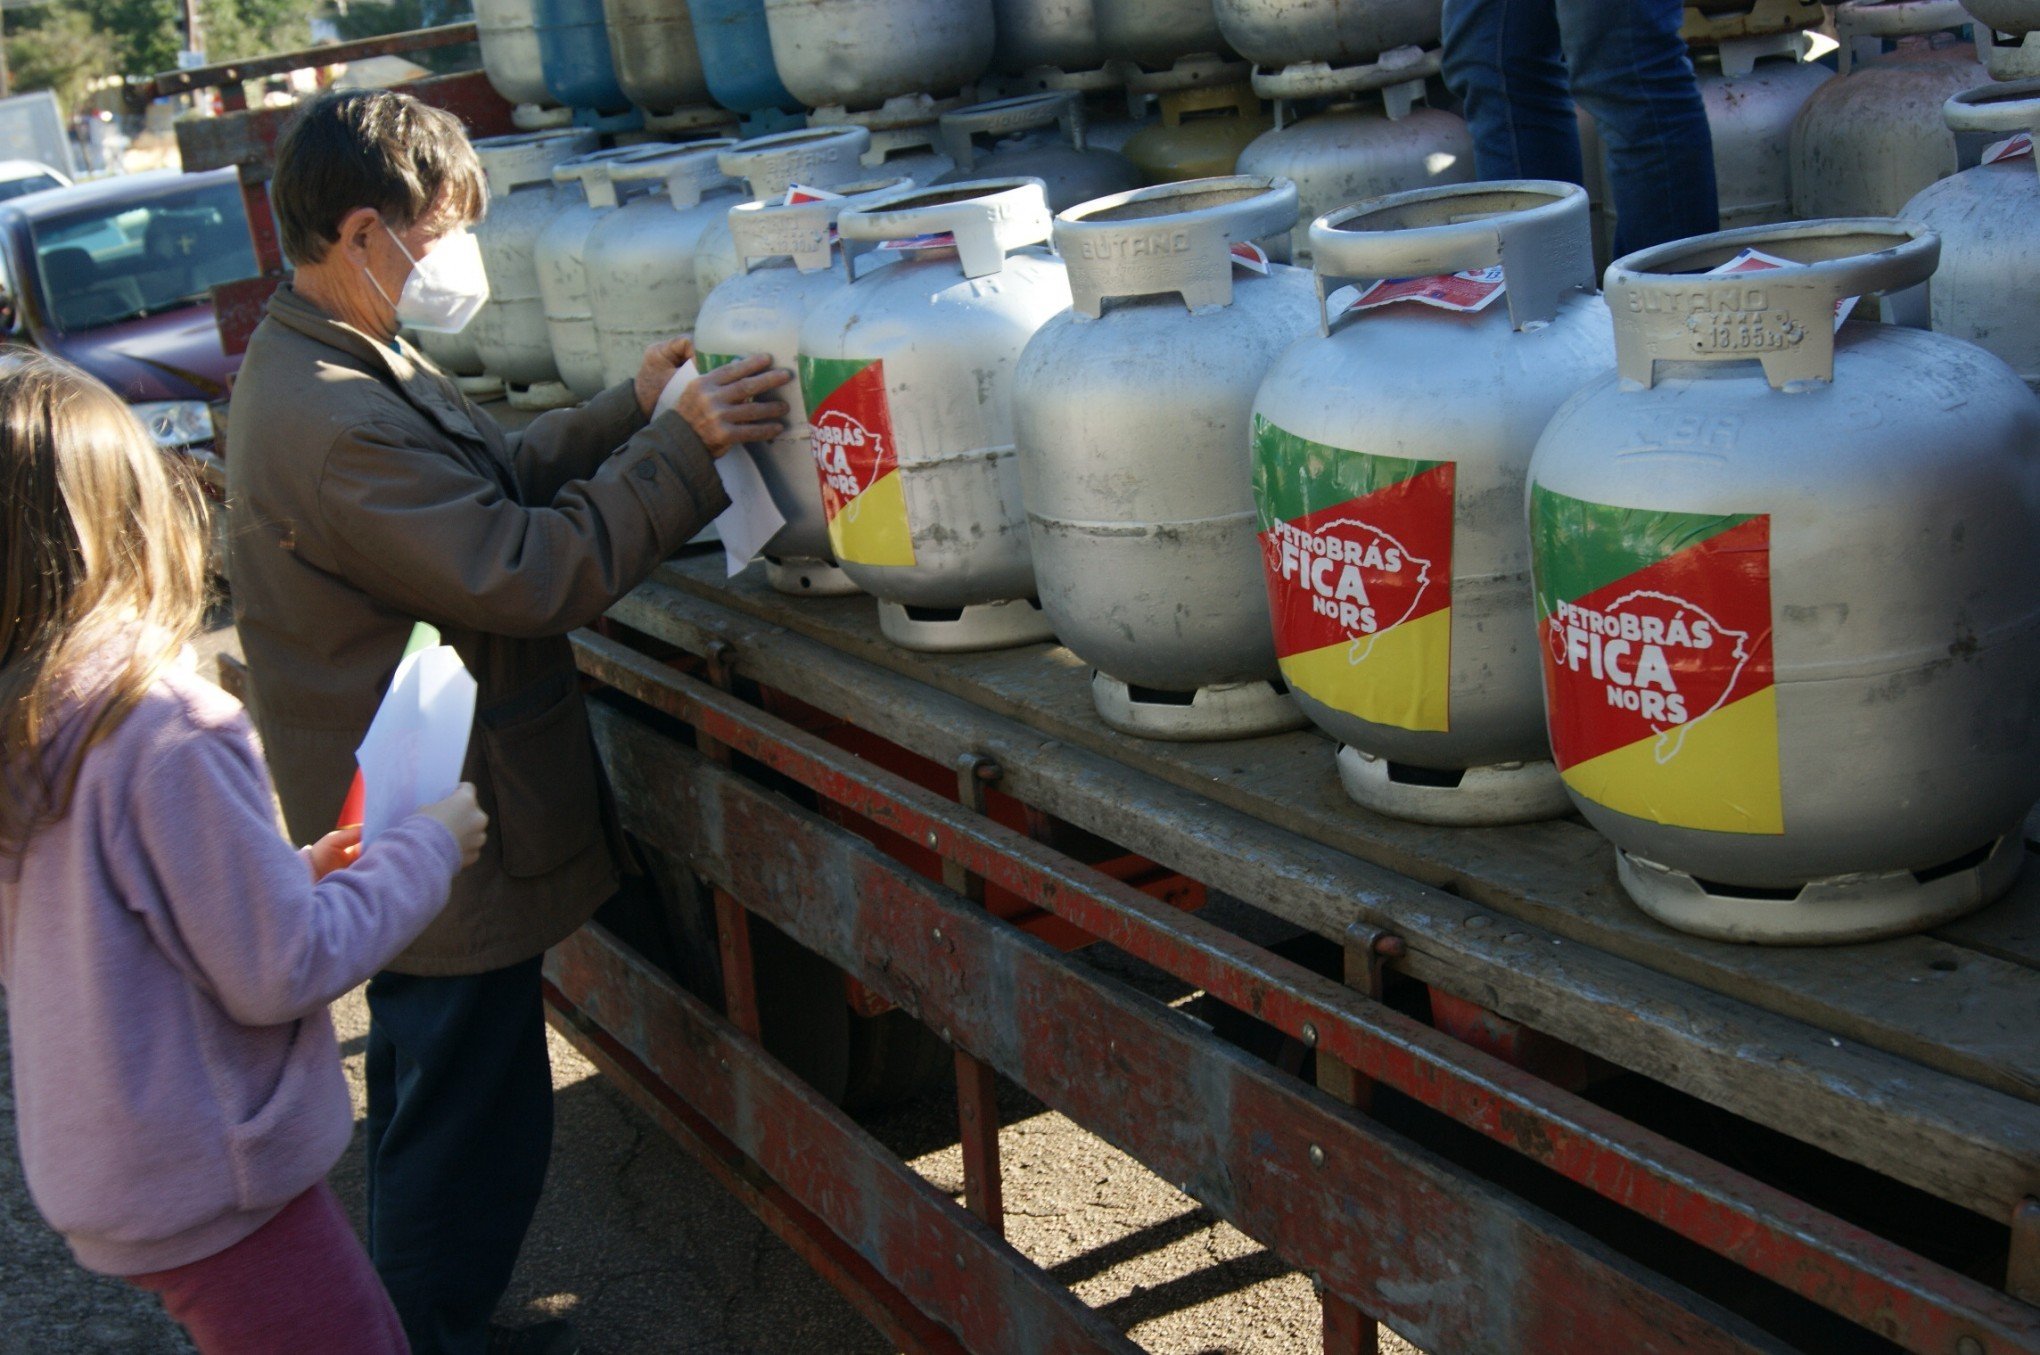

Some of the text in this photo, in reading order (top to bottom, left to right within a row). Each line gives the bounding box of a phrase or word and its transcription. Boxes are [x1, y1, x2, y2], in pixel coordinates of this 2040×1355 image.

[1080, 229, 1192, 261] BUTANO
[1627, 287, 1768, 314] BUTANO
[1273, 517, 1402, 573] PETROBRÁS
[1281, 540, 1370, 606] FICA
[1556, 599, 1713, 649] PETROBRÁS
[1567, 625, 1677, 692] FICA
